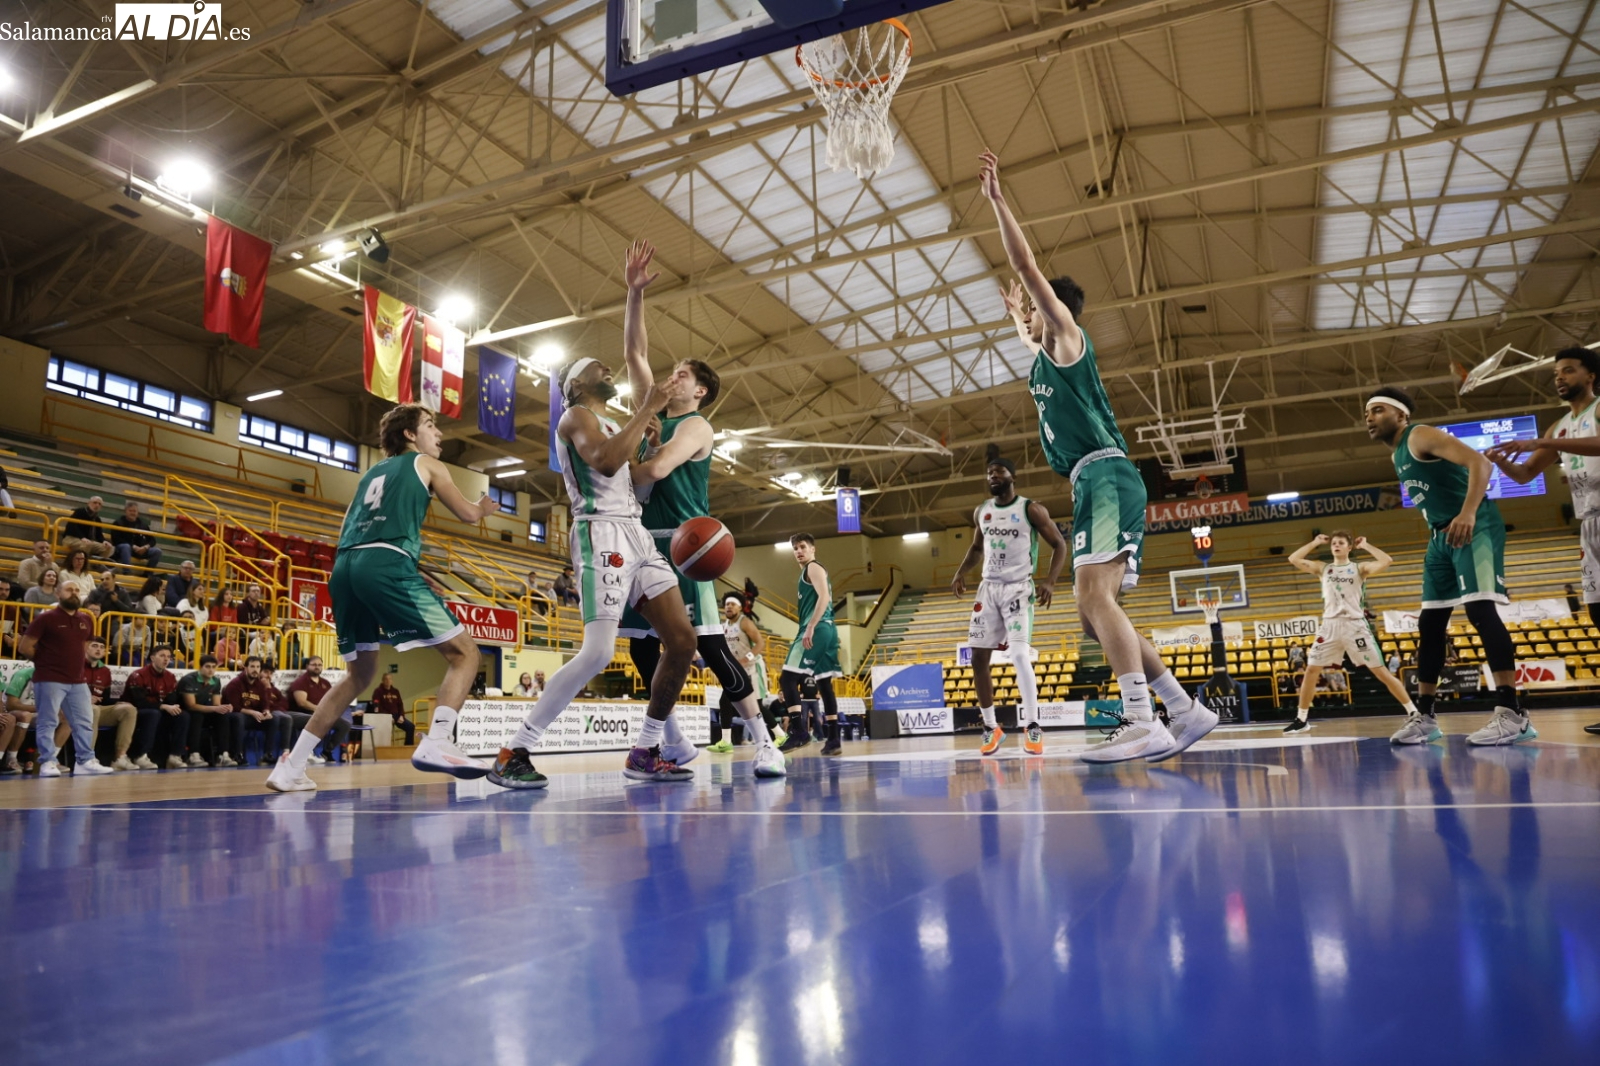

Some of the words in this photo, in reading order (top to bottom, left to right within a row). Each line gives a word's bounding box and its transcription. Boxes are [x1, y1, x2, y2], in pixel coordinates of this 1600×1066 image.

[364, 474, 386, 511] 4
[844, 497, 853, 513] 8
[1150, 506, 1174, 521] LA
[1175, 500, 1242, 519] GACETA
[1291, 500, 1312, 516] DE
[1315, 493, 1375, 513] EUROPA
[1075, 531, 1086, 551] 8
[1194, 537, 1211, 549] 10
[1258, 619, 1316, 638] SALINERO
[584, 715, 629, 736] Xoborg
